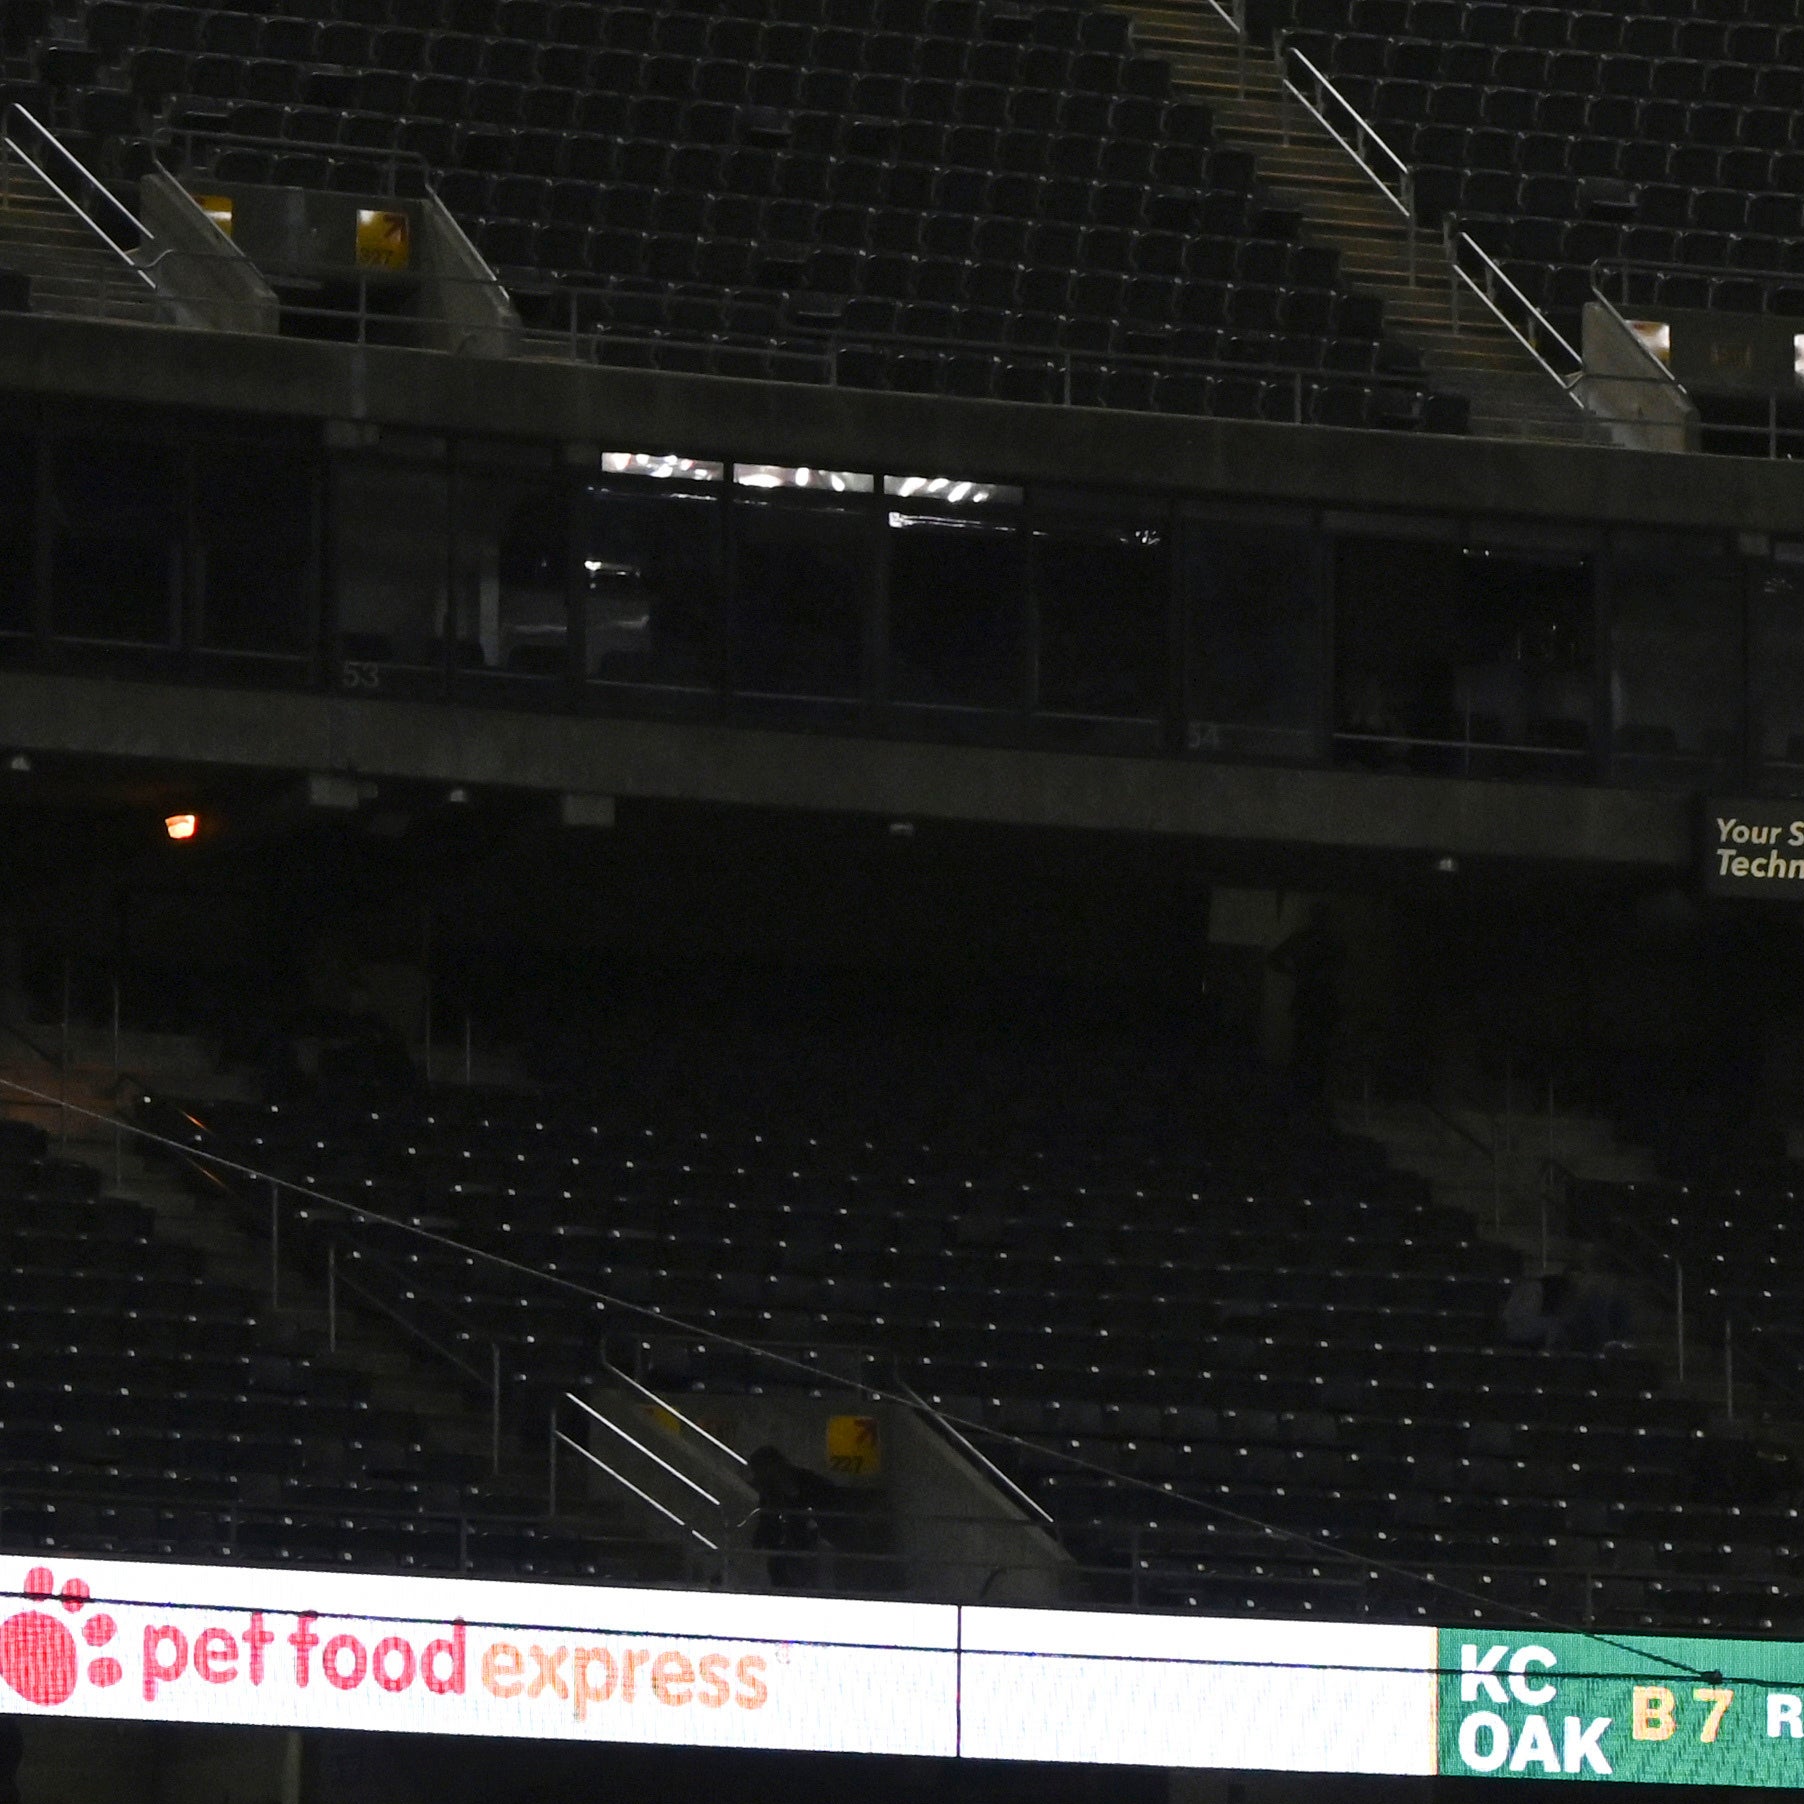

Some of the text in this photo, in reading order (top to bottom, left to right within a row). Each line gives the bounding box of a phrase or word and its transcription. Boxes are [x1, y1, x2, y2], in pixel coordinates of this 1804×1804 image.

[342, 660, 379, 688] 53
[1717, 818, 1782, 845] Your
[481, 1641, 768, 1721] express
[1460, 1643, 1557, 1705] KC
[1459, 1709, 1612, 1776] OAK
[1768, 1694, 1804, 1738] R
